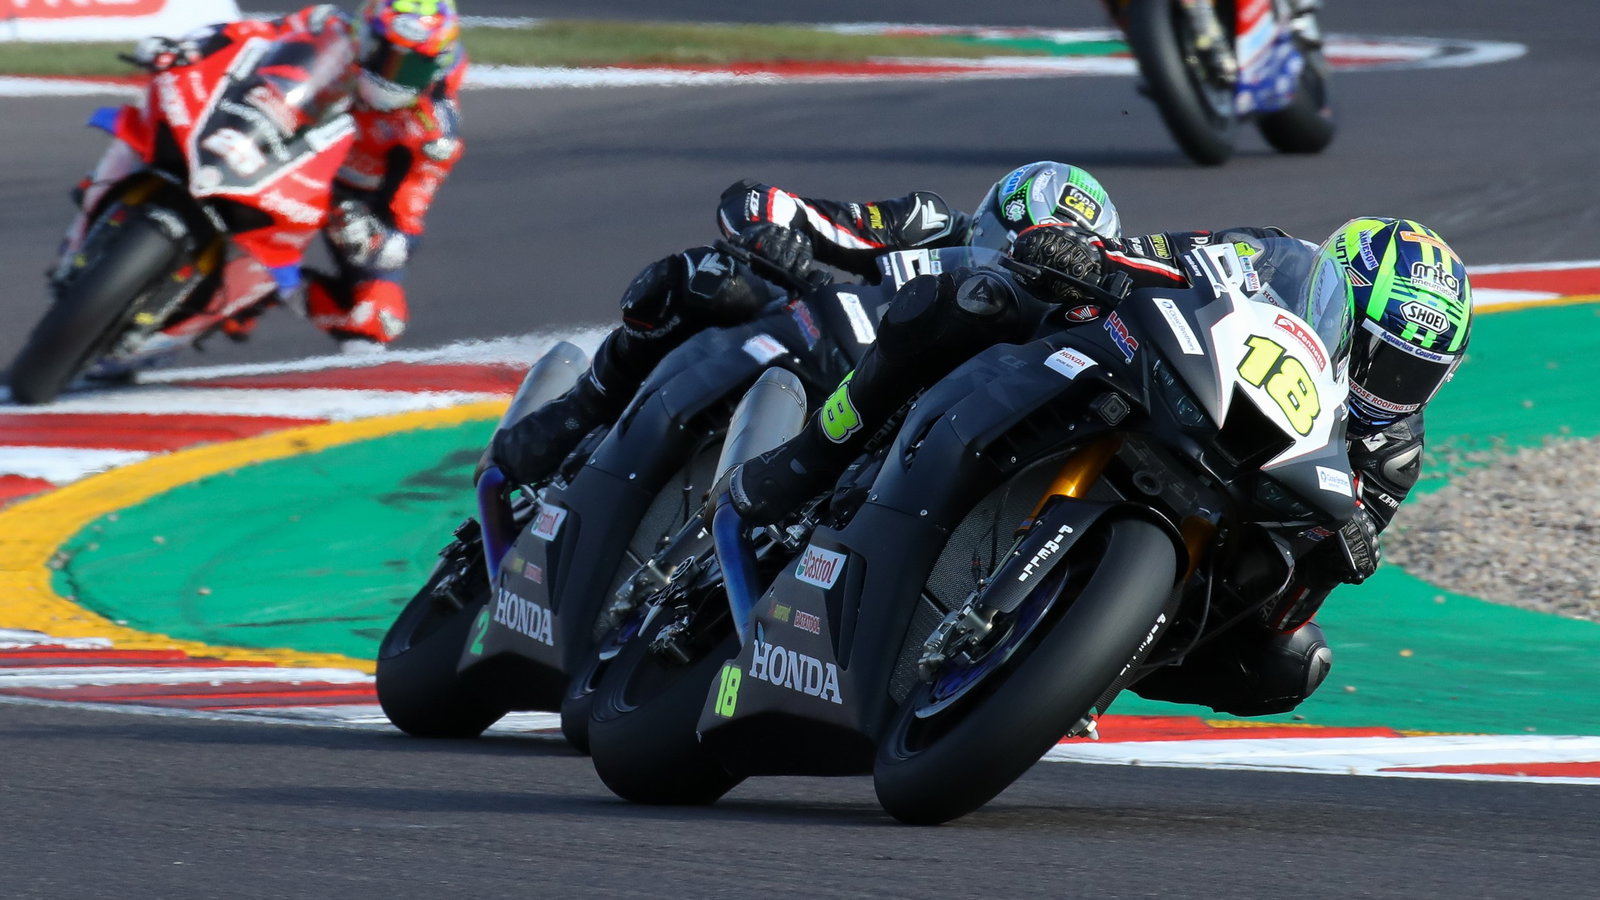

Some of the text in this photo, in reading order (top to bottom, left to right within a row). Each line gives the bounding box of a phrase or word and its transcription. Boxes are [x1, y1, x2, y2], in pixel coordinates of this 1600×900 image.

[1064, 195, 1095, 220] CAB
[1412, 262, 1459, 295] mta
[1412, 277, 1458, 300] pneumatics
[1103, 310, 1140, 361] HRC
[1408, 305, 1444, 330] SHOEI
[1059, 350, 1086, 367] HONDA
[1296, 329, 1325, 370] Bennetts
[1380, 331, 1443, 361] Aquarius Couriers
[1236, 334, 1321, 437] 18
[1371, 397, 1404, 411] ROOFING
[804, 550, 838, 585] Castrol
[1018, 524, 1074, 582] PIRELLI
[469, 610, 491, 655] 2
[494, 587, 555, 647] HONDA
[714, 664, 743, 718] 18
[748, 639, 843, 705] HONDA
